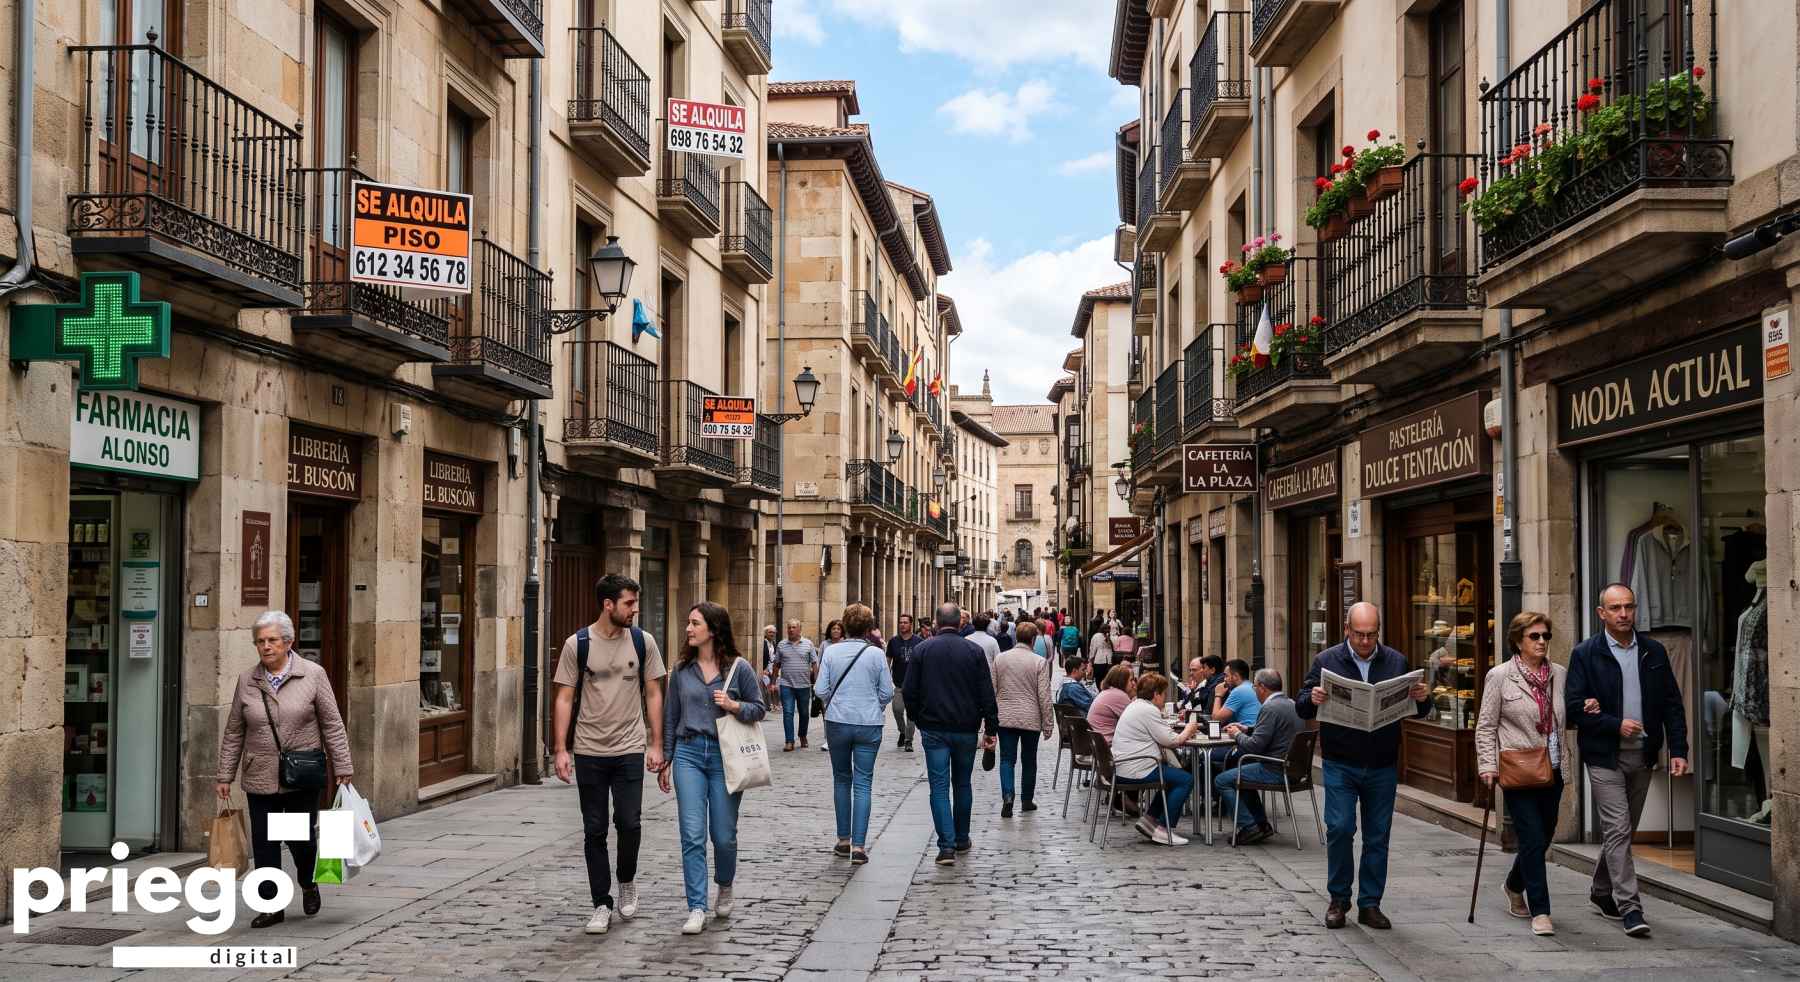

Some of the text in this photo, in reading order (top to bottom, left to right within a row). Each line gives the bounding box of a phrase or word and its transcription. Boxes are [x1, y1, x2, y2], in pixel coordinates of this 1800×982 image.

[671, 103, 743, 130] SE ALQUILA
[670, 128, 743, 154] 698 76 54 32
[357, 189, 466, 225] SE ALQUILA
[384, 226, 441, 249] PISO
[355, 250, 466, 285] 612 34 56 78
[1570, 377, 1635, 430] MODA
[1647, 345, 1750, 412] ACTUAL
[76, 389, 191, 441] FARMACIA
[705, 398, 753, 411] SE ALQUILA
[720, 424, 729, 435] 75
[731, 425, 741, 435] 54
[742, 425, 752, 436] 32
[1389, 408, 1444, 451] PASTELERÍA
[101, 436, 169, 468] ALONSO
[293, 435, 350, 464] LIBRERÍA
[1188, 447, 1253, 461] CAFETERÍA
[1365, 428, 1474, 489] DULCE TENTACIÓN
[304, 465, 356, 491] BUSCÓN
[430, 460, 472, 485] LIBRERÍA
[1213, 463, 1228, 474] LA
[1189, 476, 1253, 488] LA PLAZA
[1268, 466, 1301, 501] CAFETERÍA
[1302, 470, 1311, 493] LA
[424, 484, 475, 509] EL BUSCÓN
